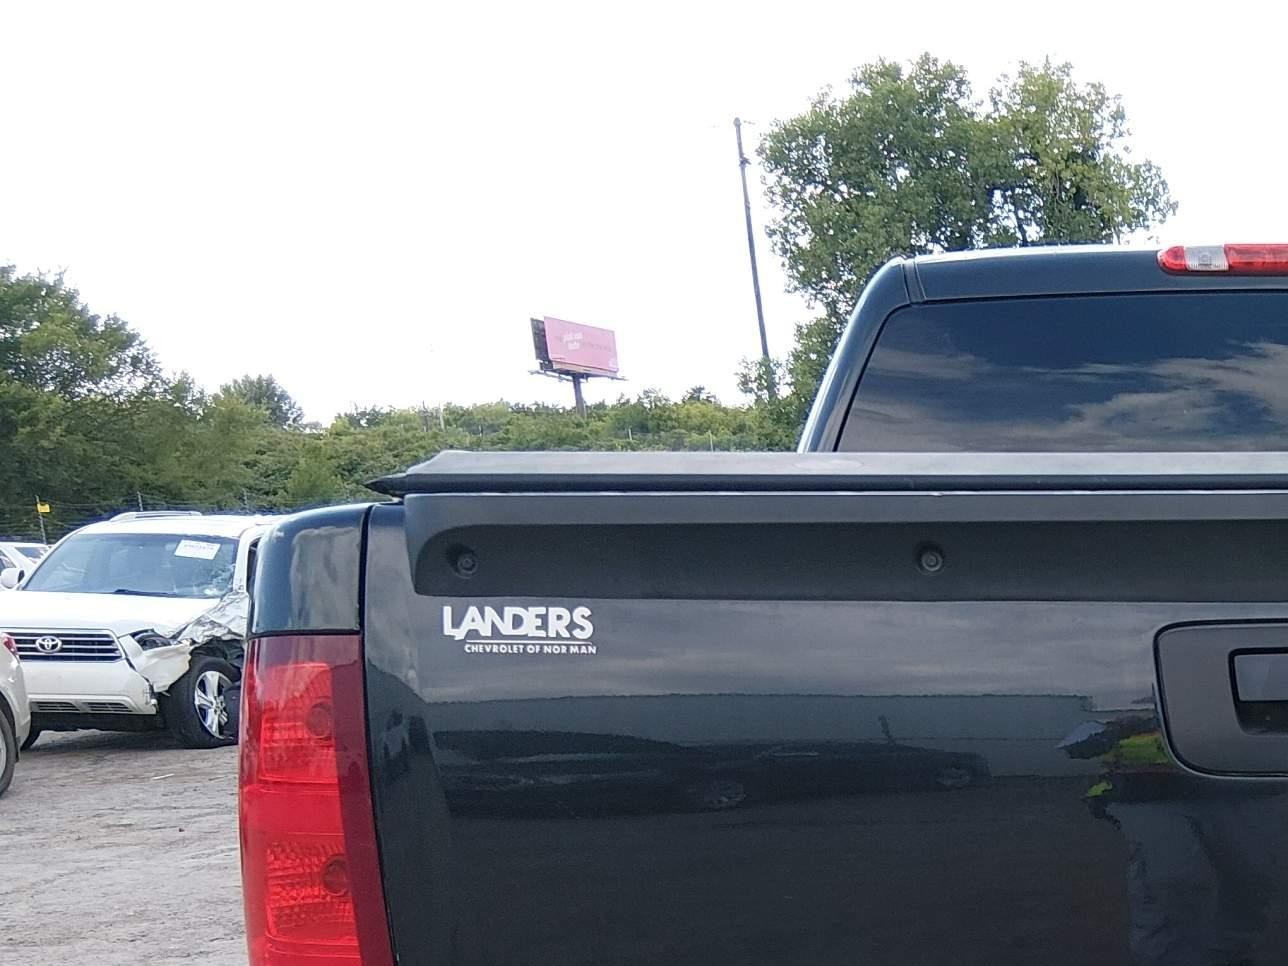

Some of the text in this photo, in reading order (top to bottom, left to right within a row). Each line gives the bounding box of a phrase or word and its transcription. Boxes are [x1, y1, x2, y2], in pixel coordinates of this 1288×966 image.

[442, 605, 594, 640] LANDERS
[464, 643, 524, 654] CHEVROLET
[526, 644, 541, 654] OF
